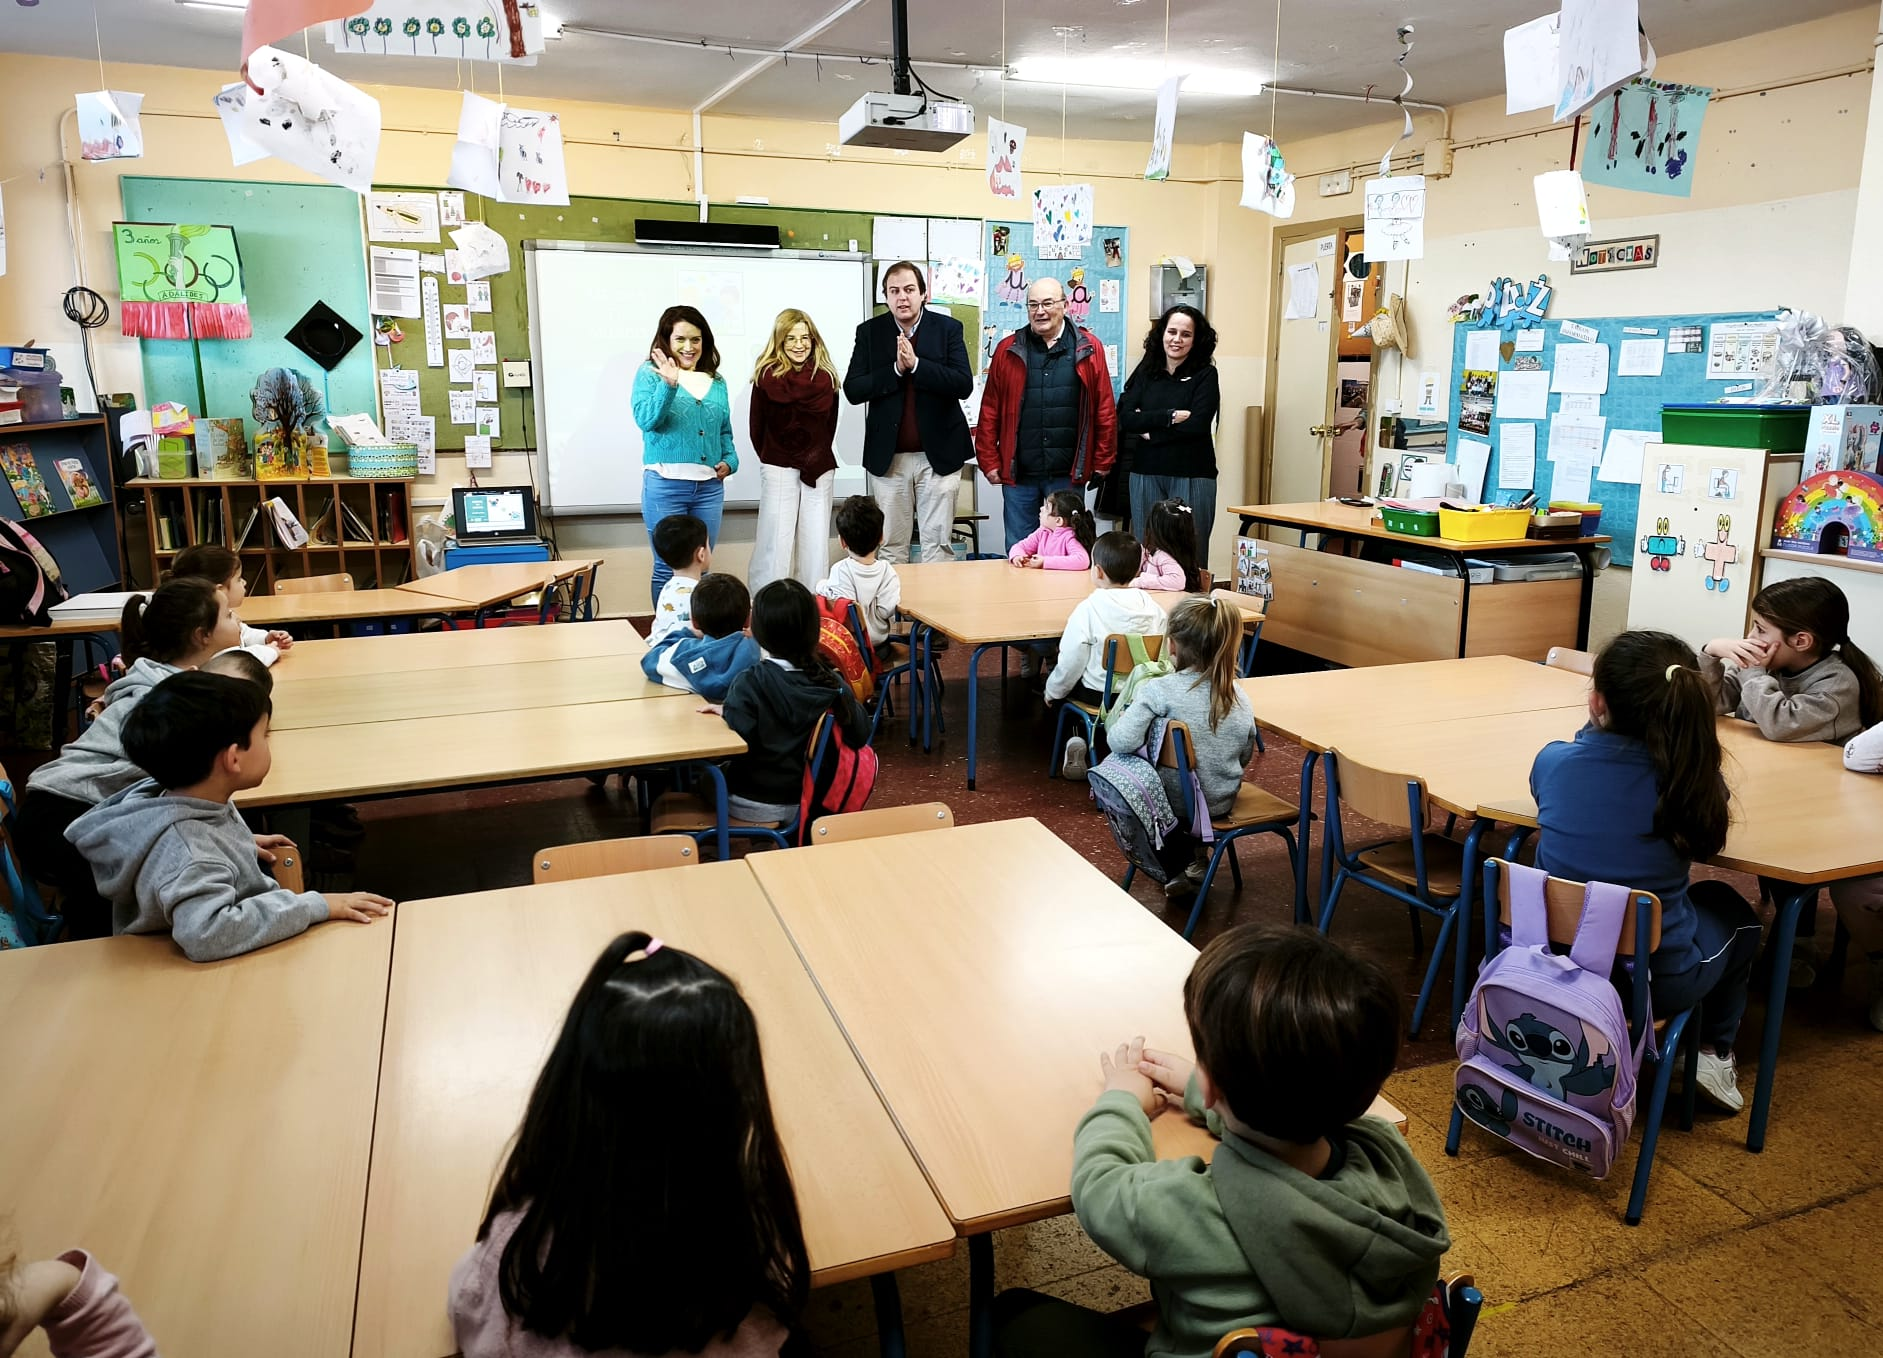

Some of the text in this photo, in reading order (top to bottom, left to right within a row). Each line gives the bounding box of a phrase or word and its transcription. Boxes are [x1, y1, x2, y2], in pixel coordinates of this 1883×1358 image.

[122, 229, 161, 245] 3 años
[1481, 280, 1552, 318] PAZ
[1523, 1111, 1592, 1153] STITCH
